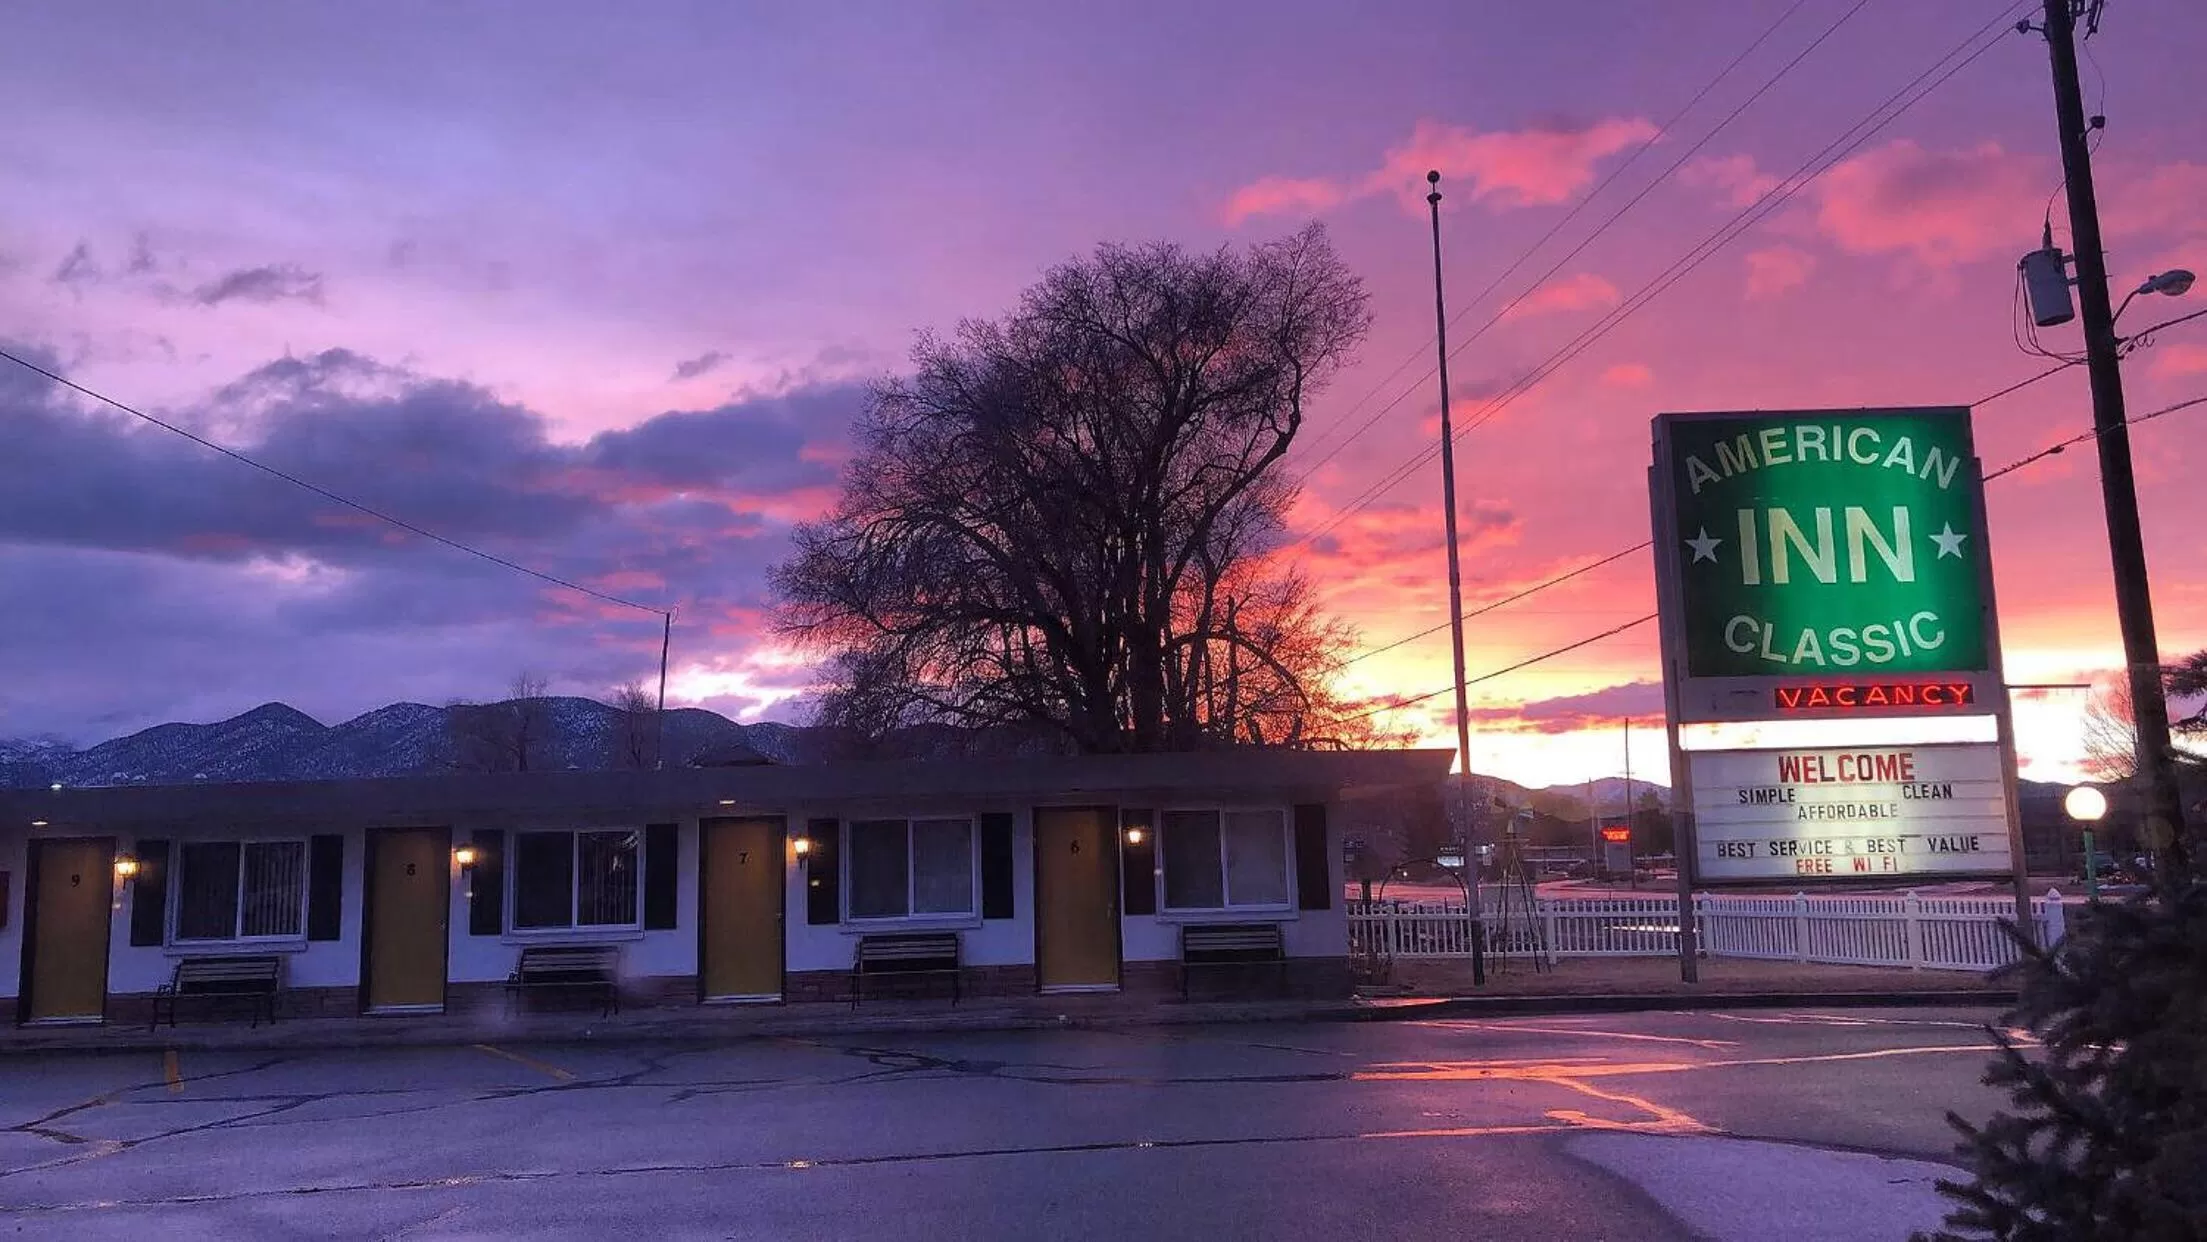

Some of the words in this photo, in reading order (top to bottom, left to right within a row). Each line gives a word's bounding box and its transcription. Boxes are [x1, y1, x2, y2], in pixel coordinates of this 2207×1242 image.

[1685, 424, 1960, 495] AMERICAN
[1737, 506, 1915, 585] INN
[1724, 611, 1945, 666] CLASSIC
[1779, 685, 1969, 708] VACANCY
[1778, 753, 1915, 783] WELCOME
[1739, 788, 1796, 804] SIMPLE
[1903, 784, 1953, 799] CLEAN
[1798, 804, 1898, 820] AFFORDABLE
[739, 851, 749, 865] 7
[1717, 842, 1756, 858] BEST
[1769, 840, 1832, 856] SERVICE
[1868, 839, 1906, 853] BEST
[1928, 836, 1979, 852] VALUE
[1796, 859, 1832, 874] FREE
[1853, 857, 1871, 872] WI
[1884, 857, 1898, 872] FI
[71, 873, 80, 888] 9
